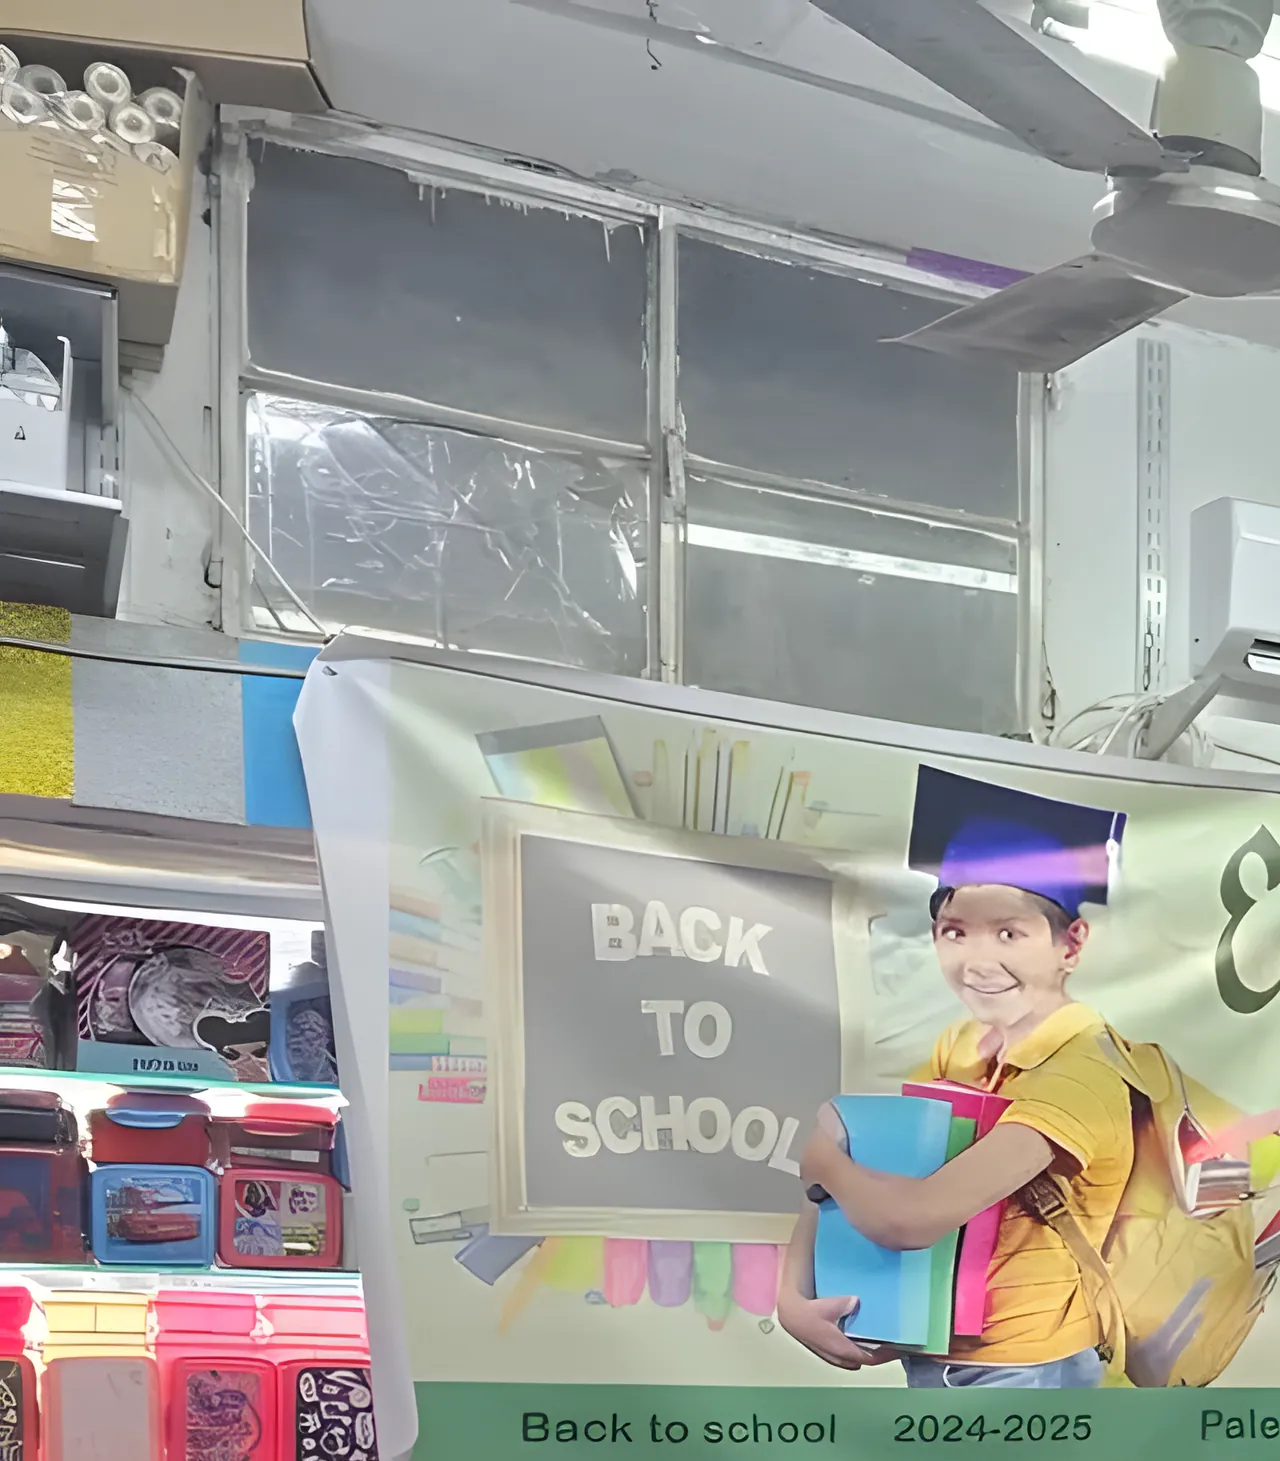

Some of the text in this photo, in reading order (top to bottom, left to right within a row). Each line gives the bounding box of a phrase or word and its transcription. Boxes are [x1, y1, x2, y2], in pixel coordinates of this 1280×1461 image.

[591, 900, 774, 976] BACK
[641, 999, 733, 1059] TO
[554, 1095, 801, 1178] SCHOOL
[522, 1411, 633, 1444] Back
[650, 1414, 689, 1445] to
[703, 1413, 837, 1445] school
[893, 1413, 1092, 1443] 2024-2025
